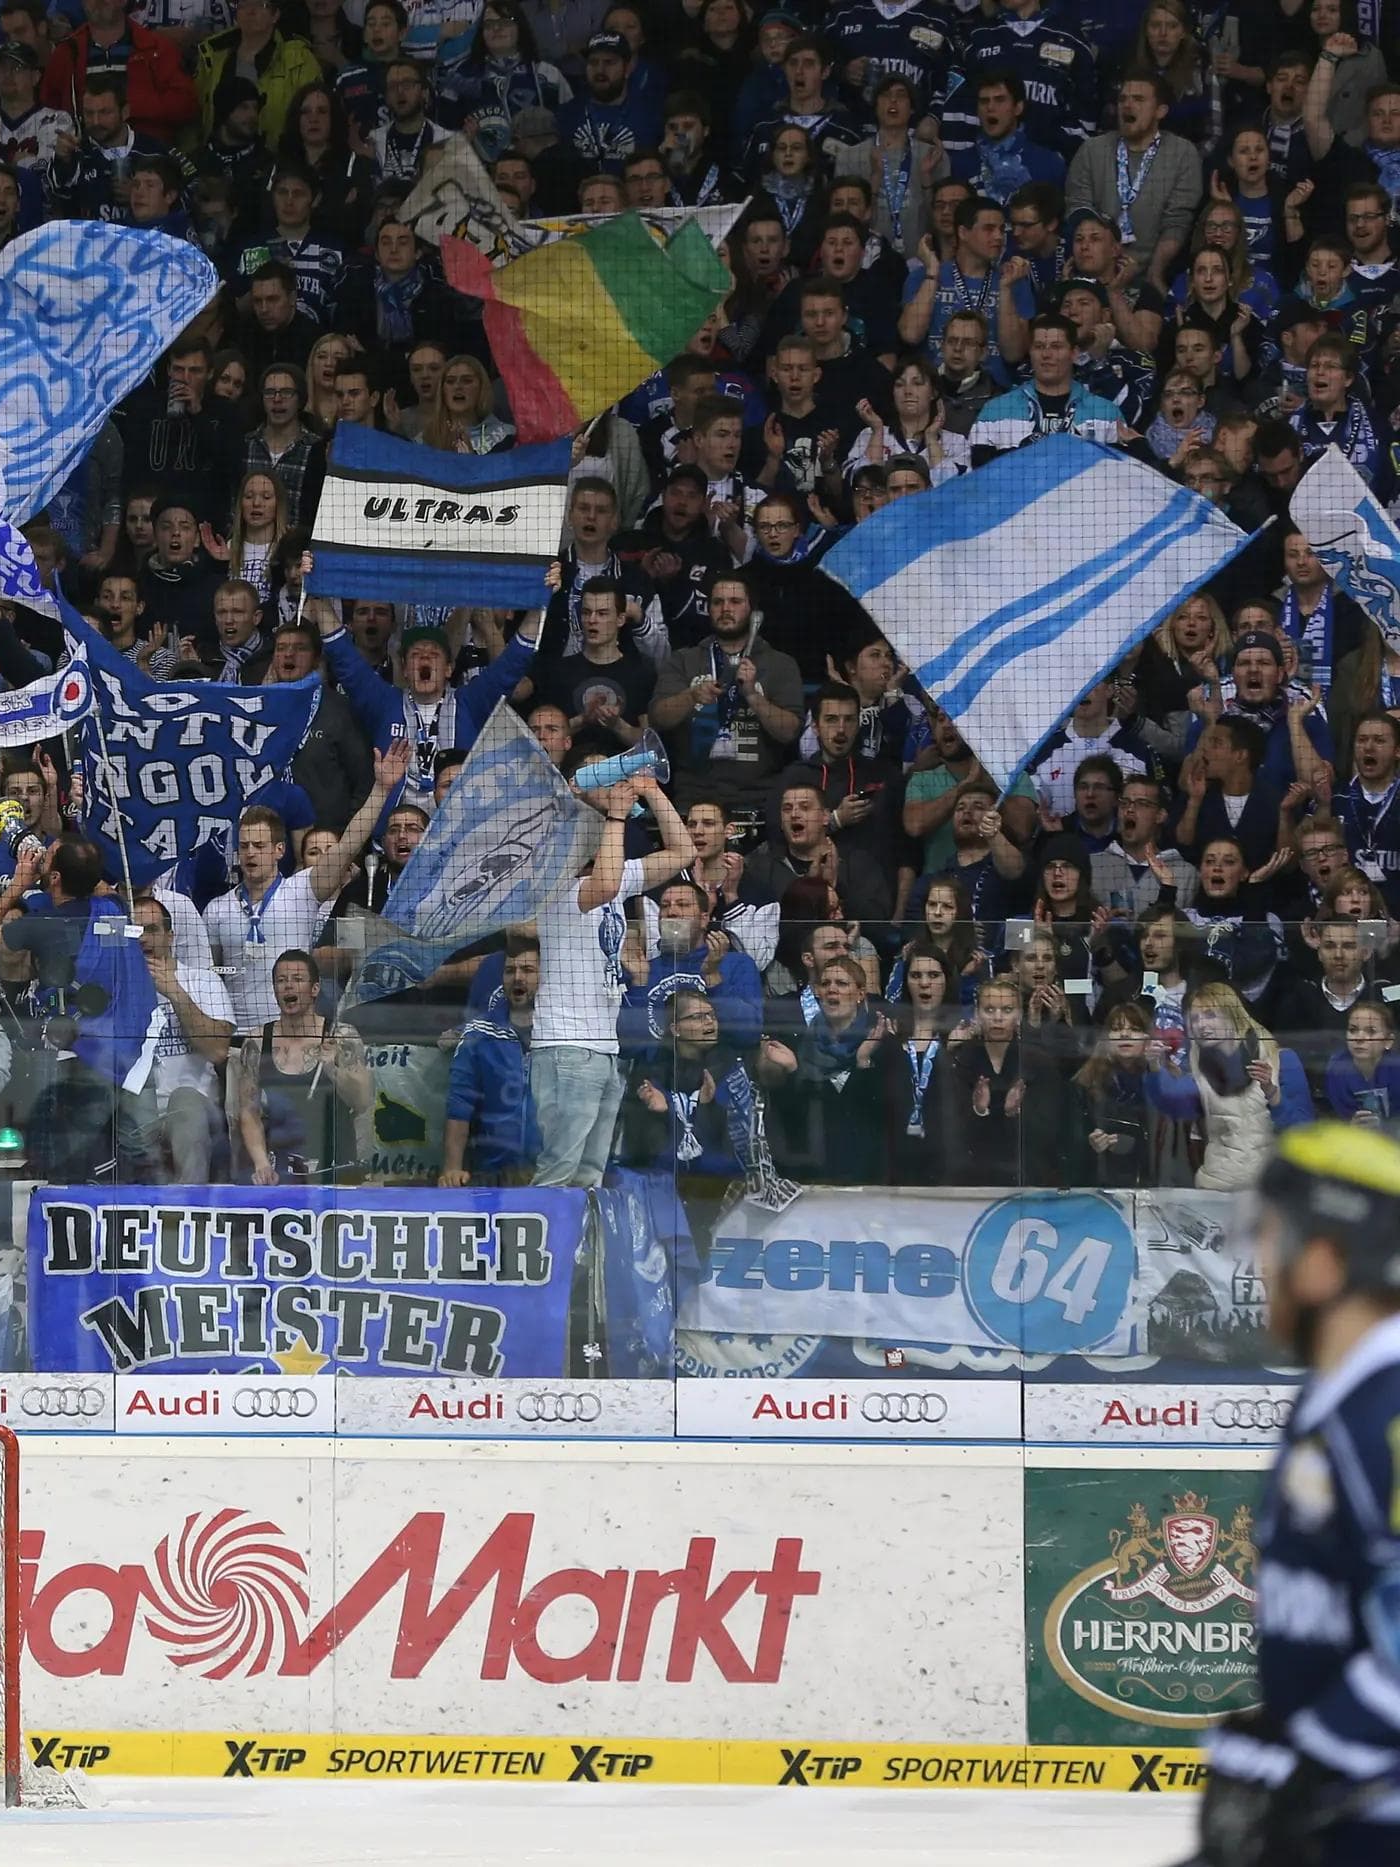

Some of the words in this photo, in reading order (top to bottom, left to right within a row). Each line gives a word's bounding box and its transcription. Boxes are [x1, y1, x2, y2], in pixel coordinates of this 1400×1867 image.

[363, 496, 521, 526] ULTRAS
[44, 1203, 552, 1286] DEUTSCHER
[700, 1236, 960, 1299] zene
[988, 1216, 1114, 1326] 64
[81, 1284, 506, 1377] MEISTER
[126, 1390, 220, 1416] Audi
[409, 1393, 502, 1420] Audi
[752, 1394, 848, 1420] Audi
[1101, 1400, 1198, 1426] Audi
[280, 1512, 821, 1684] Markt
[1152, 1585, 1227, 1612] INGOLSTADT
[1218, 1567, 1257, 1601] BAVARI
[1073, 1619, 1258, 1655] HERRNBR
[327, 1750, 544, 1774] SPORTWETTEN
[884, 1758, 1104, 1783] SPORTWETTEN
